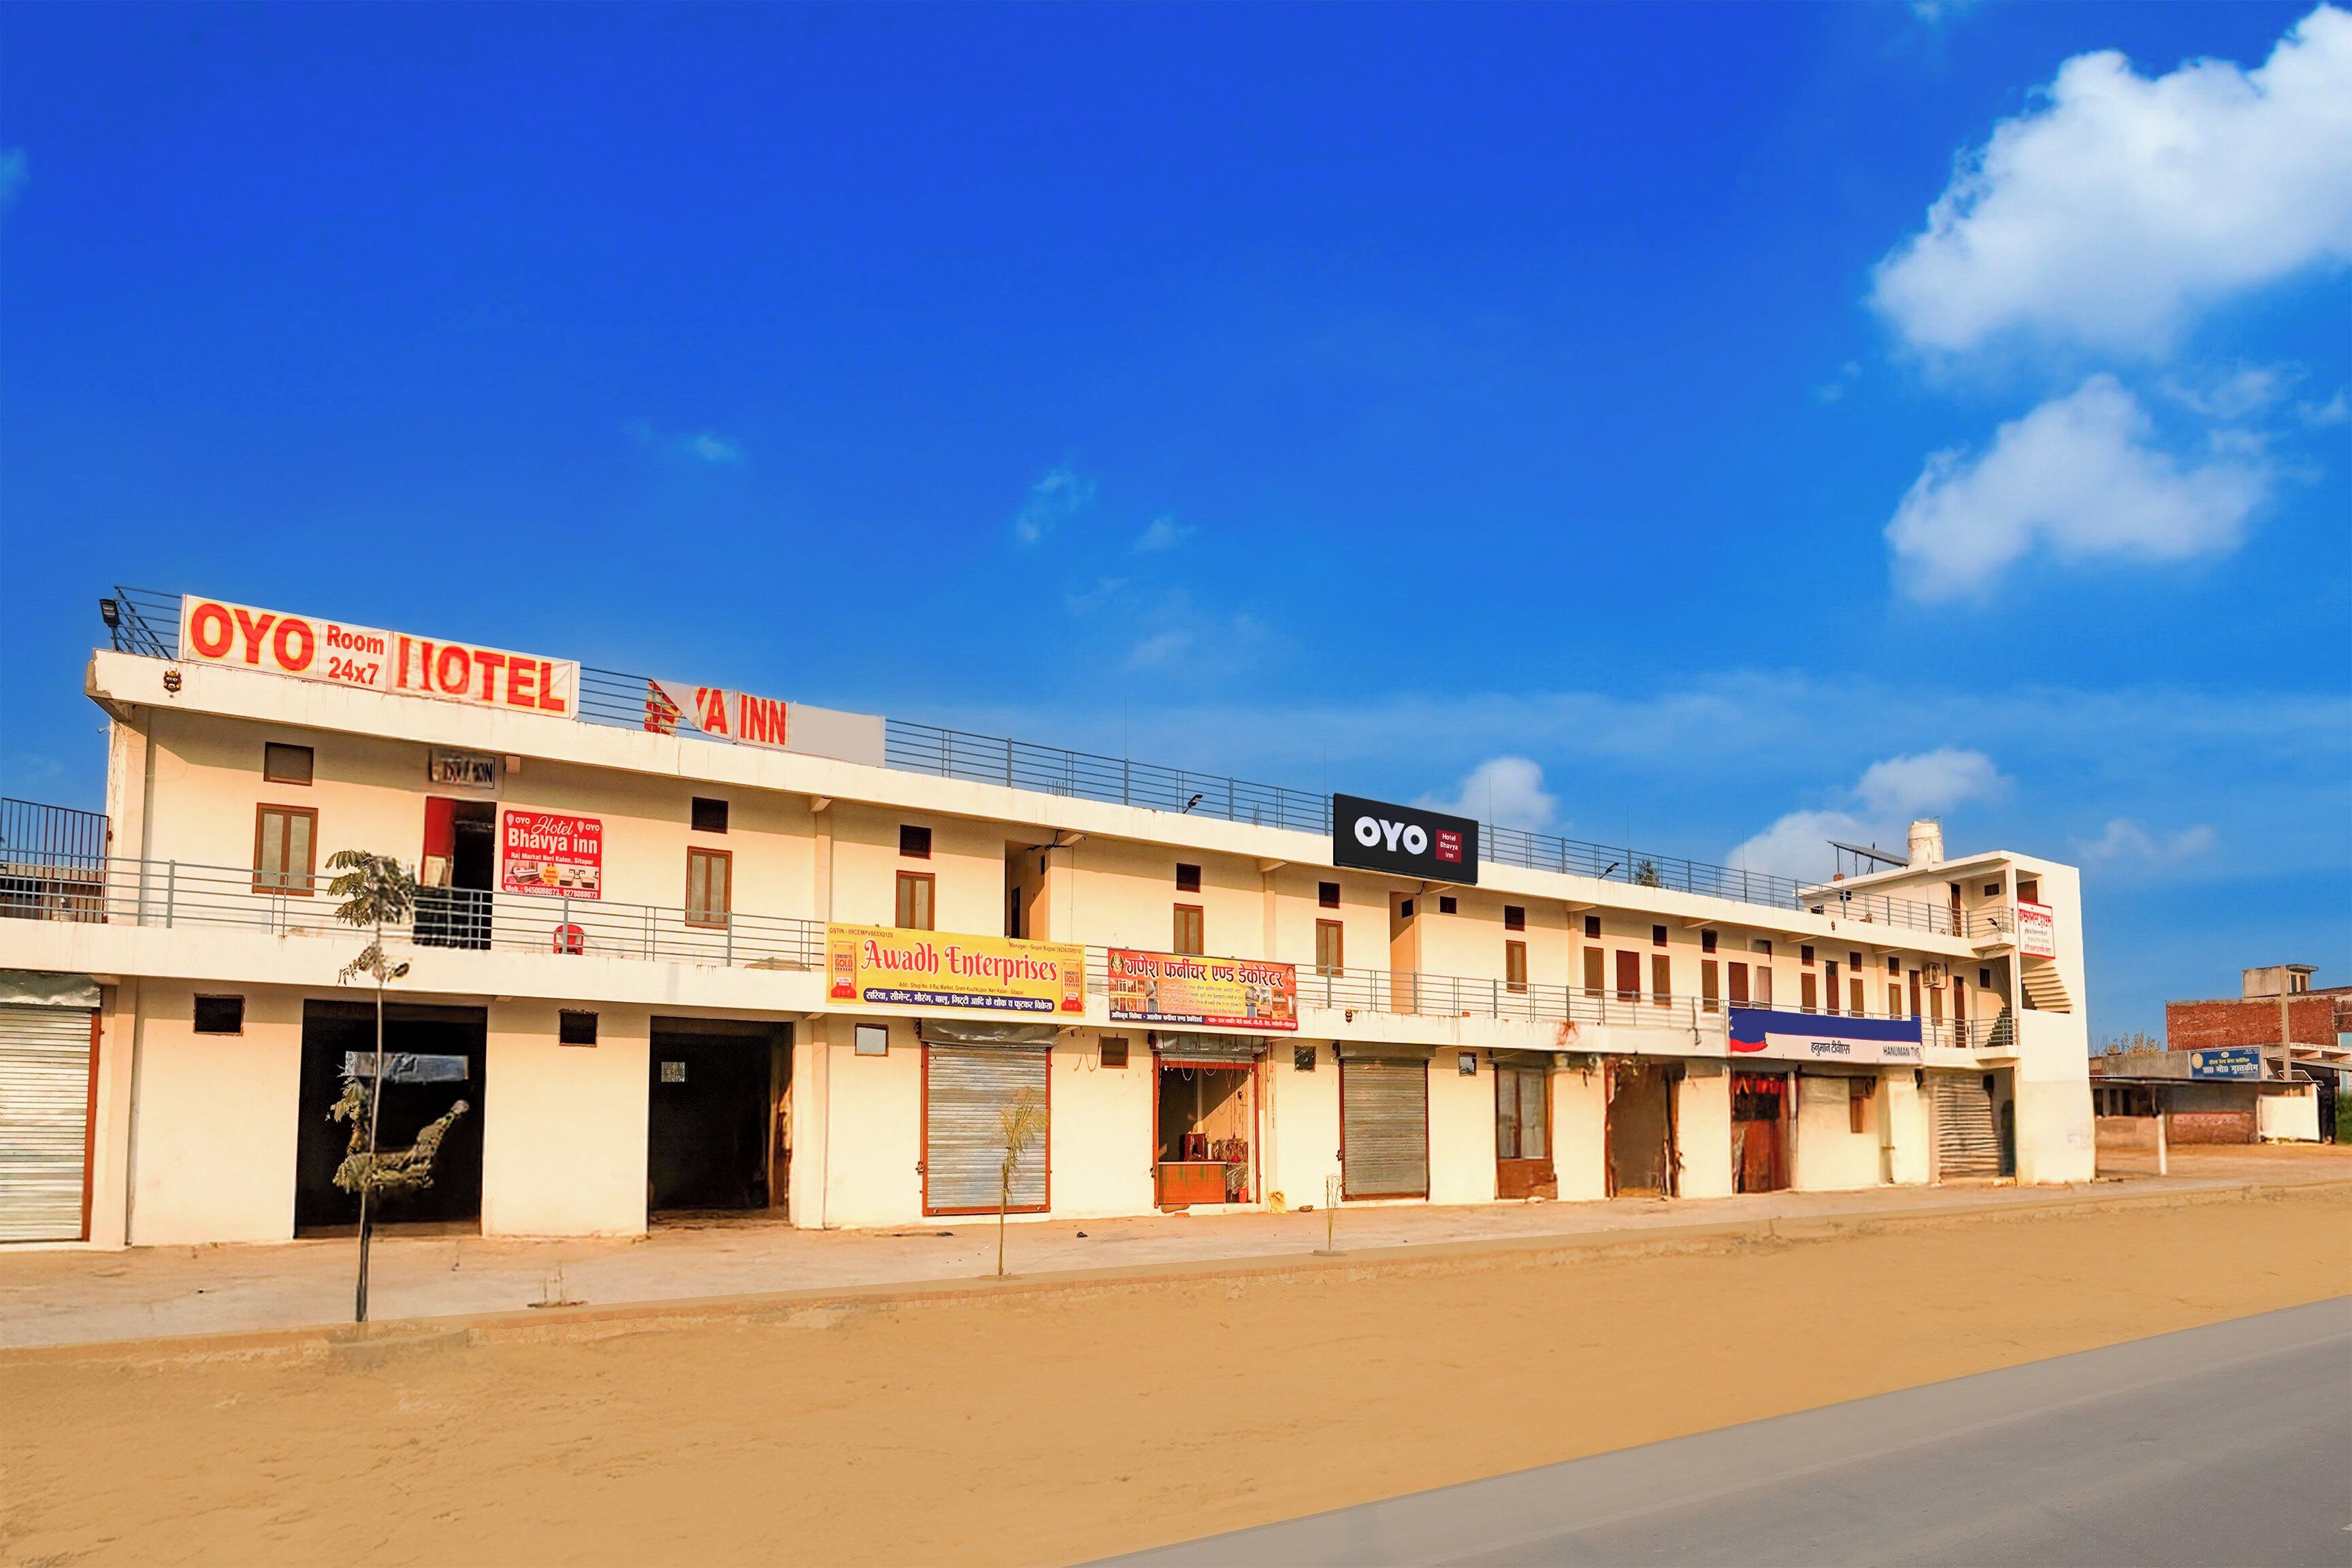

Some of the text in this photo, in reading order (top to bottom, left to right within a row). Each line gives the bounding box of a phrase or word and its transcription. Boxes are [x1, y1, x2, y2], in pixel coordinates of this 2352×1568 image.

[191, 602, 314, 672] OYO
[327, 625, 384, 655] Room
[328, 656, 380, 685] 24x7
[398, 636, 566, 712] HOTEL
[740, 694, 787, 745] INN
[531, 815, 574, 835] Hotel
[585, 823, 600, 832] OYO
[1354, 816, 1428, 855] OYO
[1442, 833, 1456, 842] Hotel
[508, 828, 598, 854] Bhavya inn
[1440, 841, 1458, 851] Bhavya
[835, 958, 853, 967] GOLD
[861, 940, 1056, 986] Awadh Enterprises
[1125, 956, 1284, 987] गणेश फर्नीचर एण्ड डेकोरेटर
[866, 990, 888, 1001] सरिया,
[970, 995, 984, 1006] आदि
[985, 996, 993, 1006] के
[994, 996, 1007, 1007] थोक
[1811, 1040, 1850, 1056] हनुमान टीवीएस
[1883, 1046, 1910, 1056] HANUMAN
